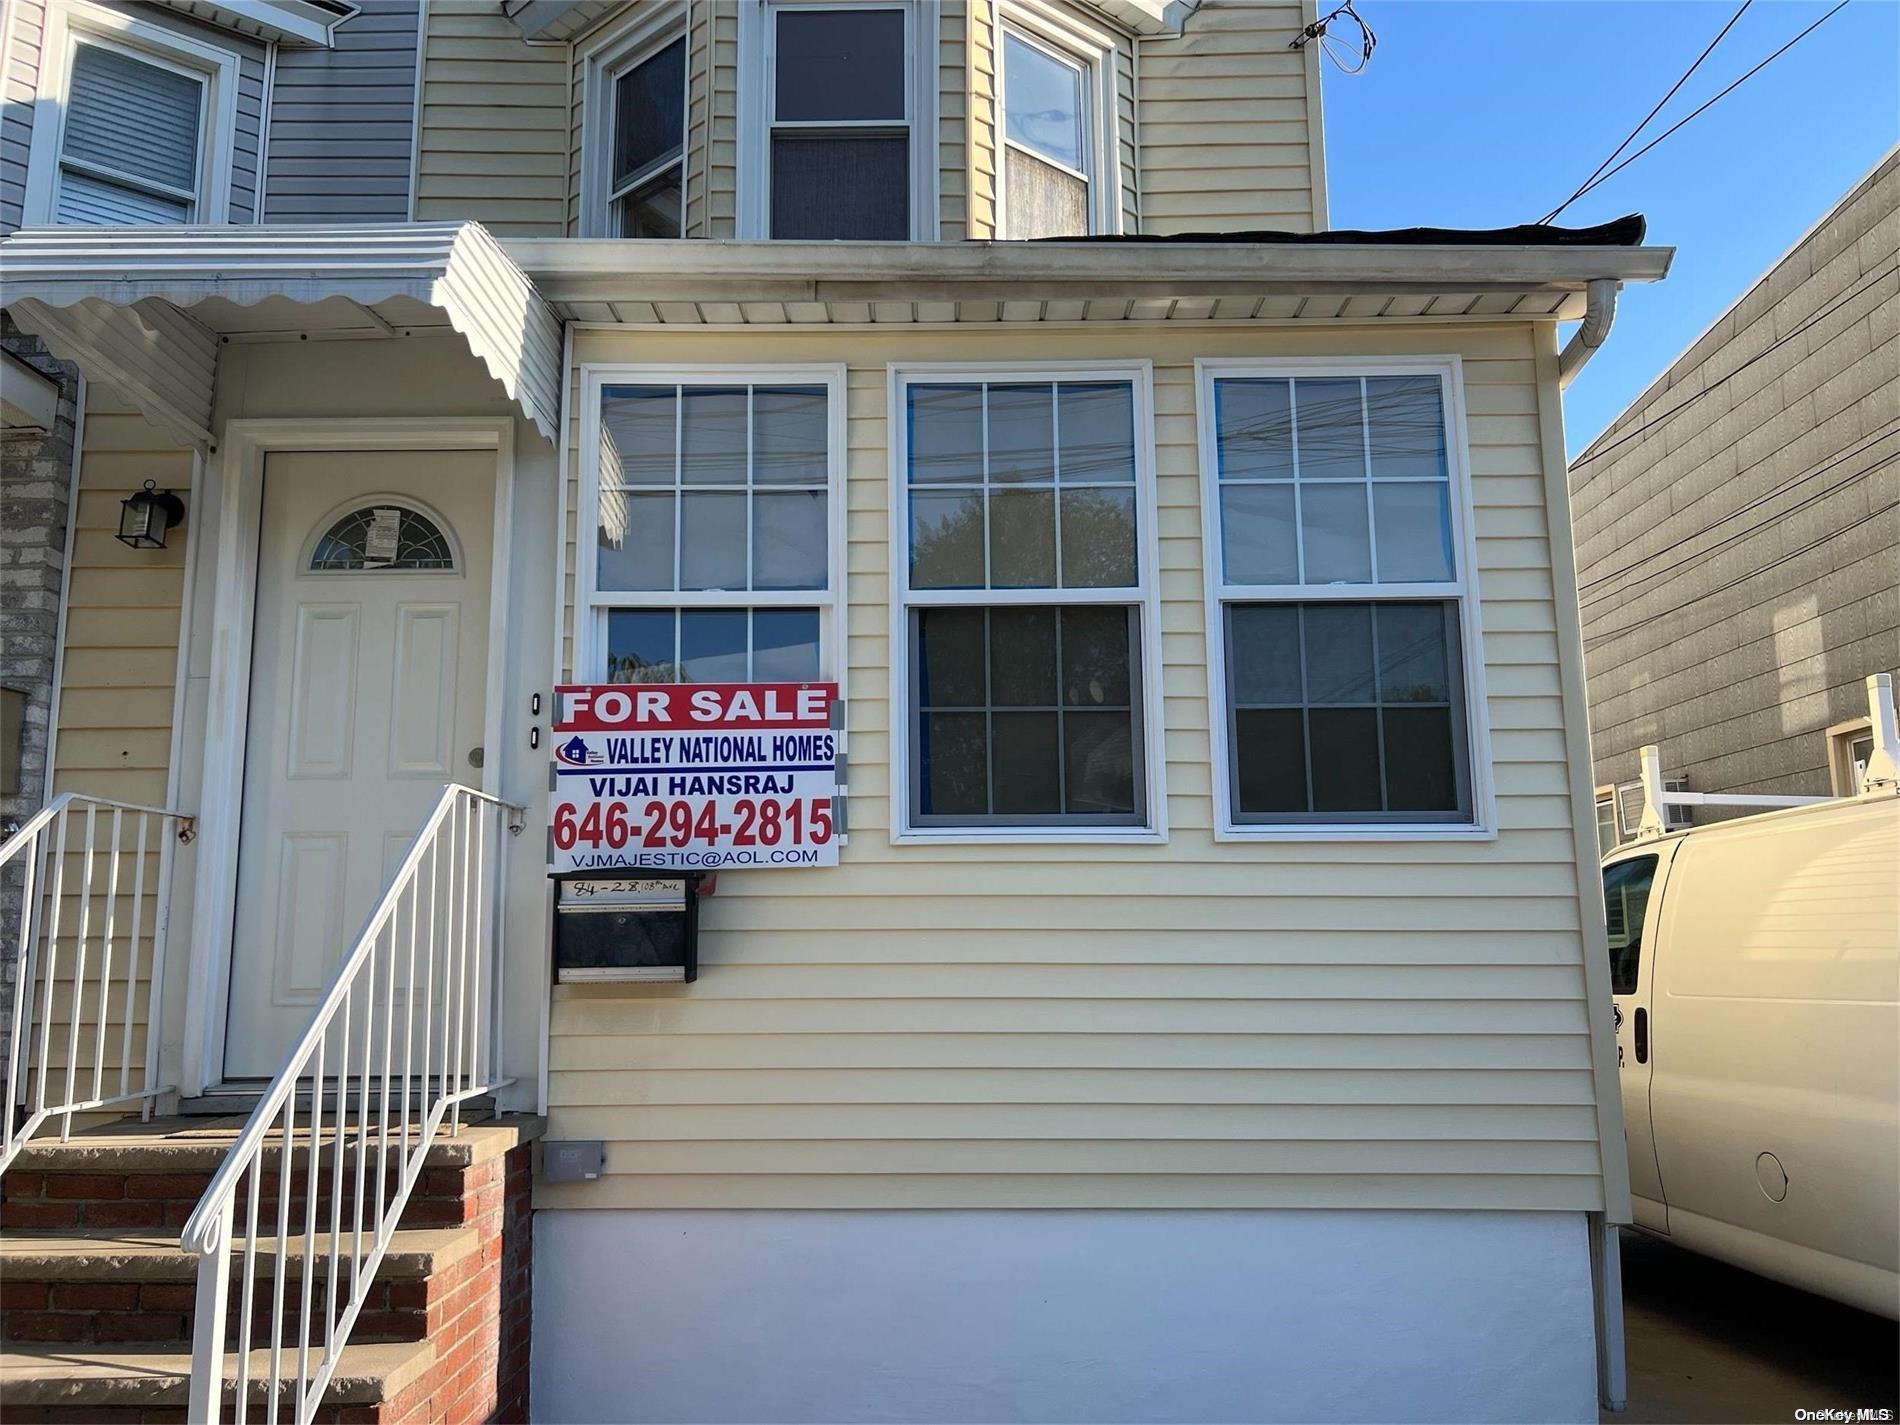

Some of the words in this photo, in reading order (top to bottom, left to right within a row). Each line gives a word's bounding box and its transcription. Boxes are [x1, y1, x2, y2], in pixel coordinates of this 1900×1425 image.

[561, 691, 673, 724] FOR
[689, 689, 828, 722] SALE
[606, 737, 673, 764] VALLEY
[679, 735, 767, 763] NATIONAL
[772, 734, 834, 762] HOMES
[589, 777, 658, 797] VIJAI
[669, 774, 795, 796] HANSRAJ
[554, 798, 832, 850] 646-294-2815
[571, 850, 818, 868] VJMAJESTIC@AOL.COM
